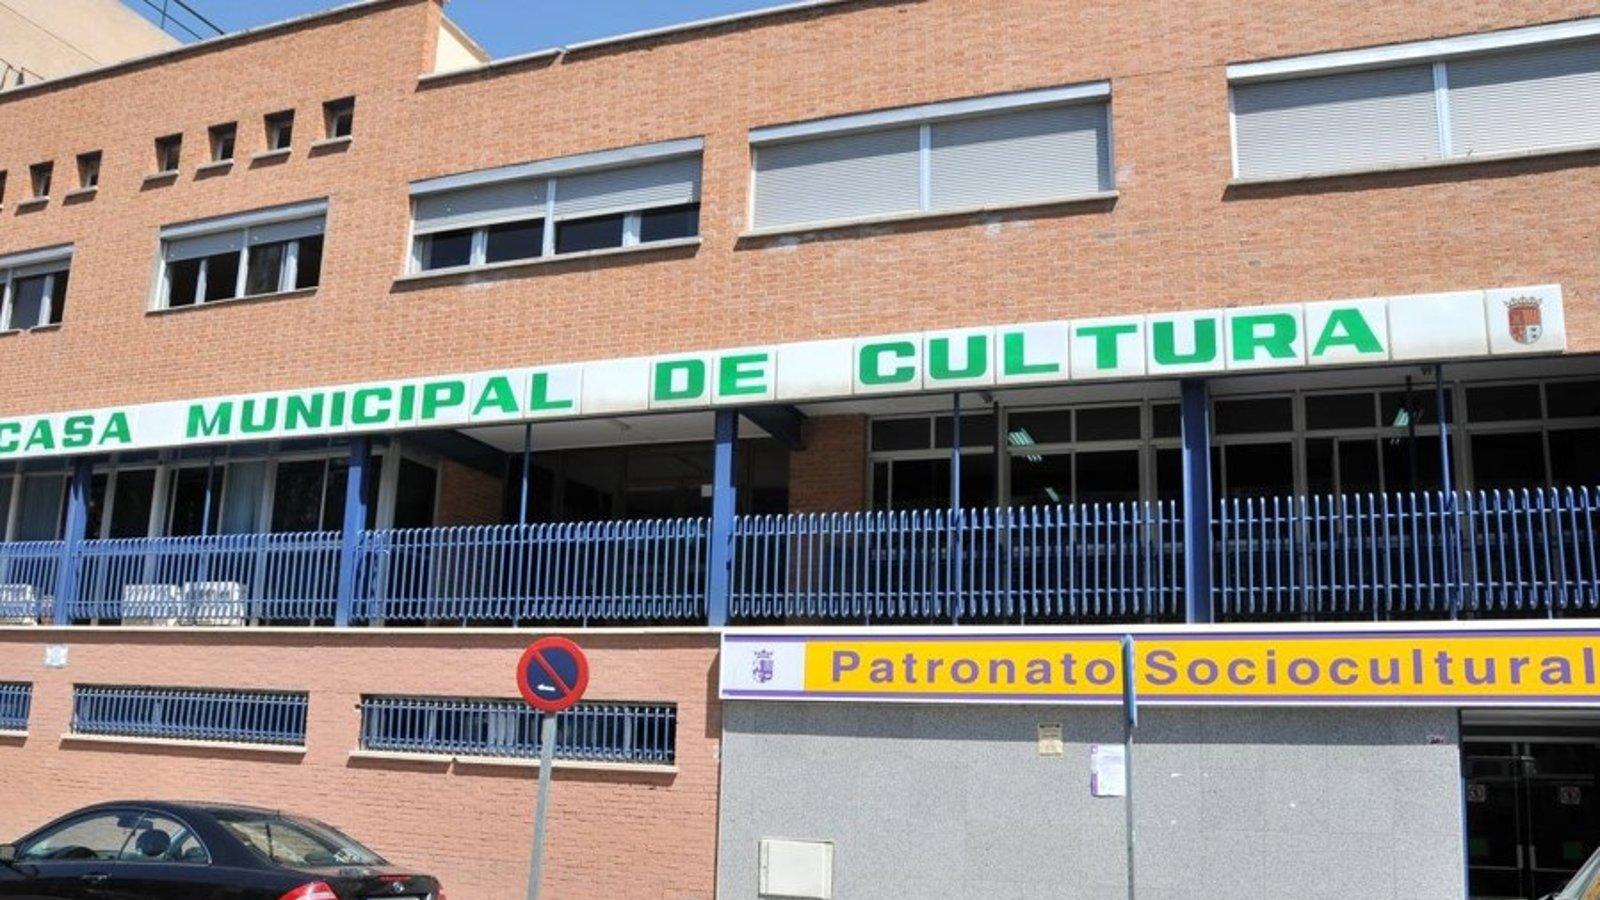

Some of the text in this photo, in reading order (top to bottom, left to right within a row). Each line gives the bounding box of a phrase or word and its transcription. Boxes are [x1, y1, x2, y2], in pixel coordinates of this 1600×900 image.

[0, 306, 1387, 453] CASA MUNICIPAL DE CULTURA
[831, 647, 1596, 686] Patronato Sociocultural
